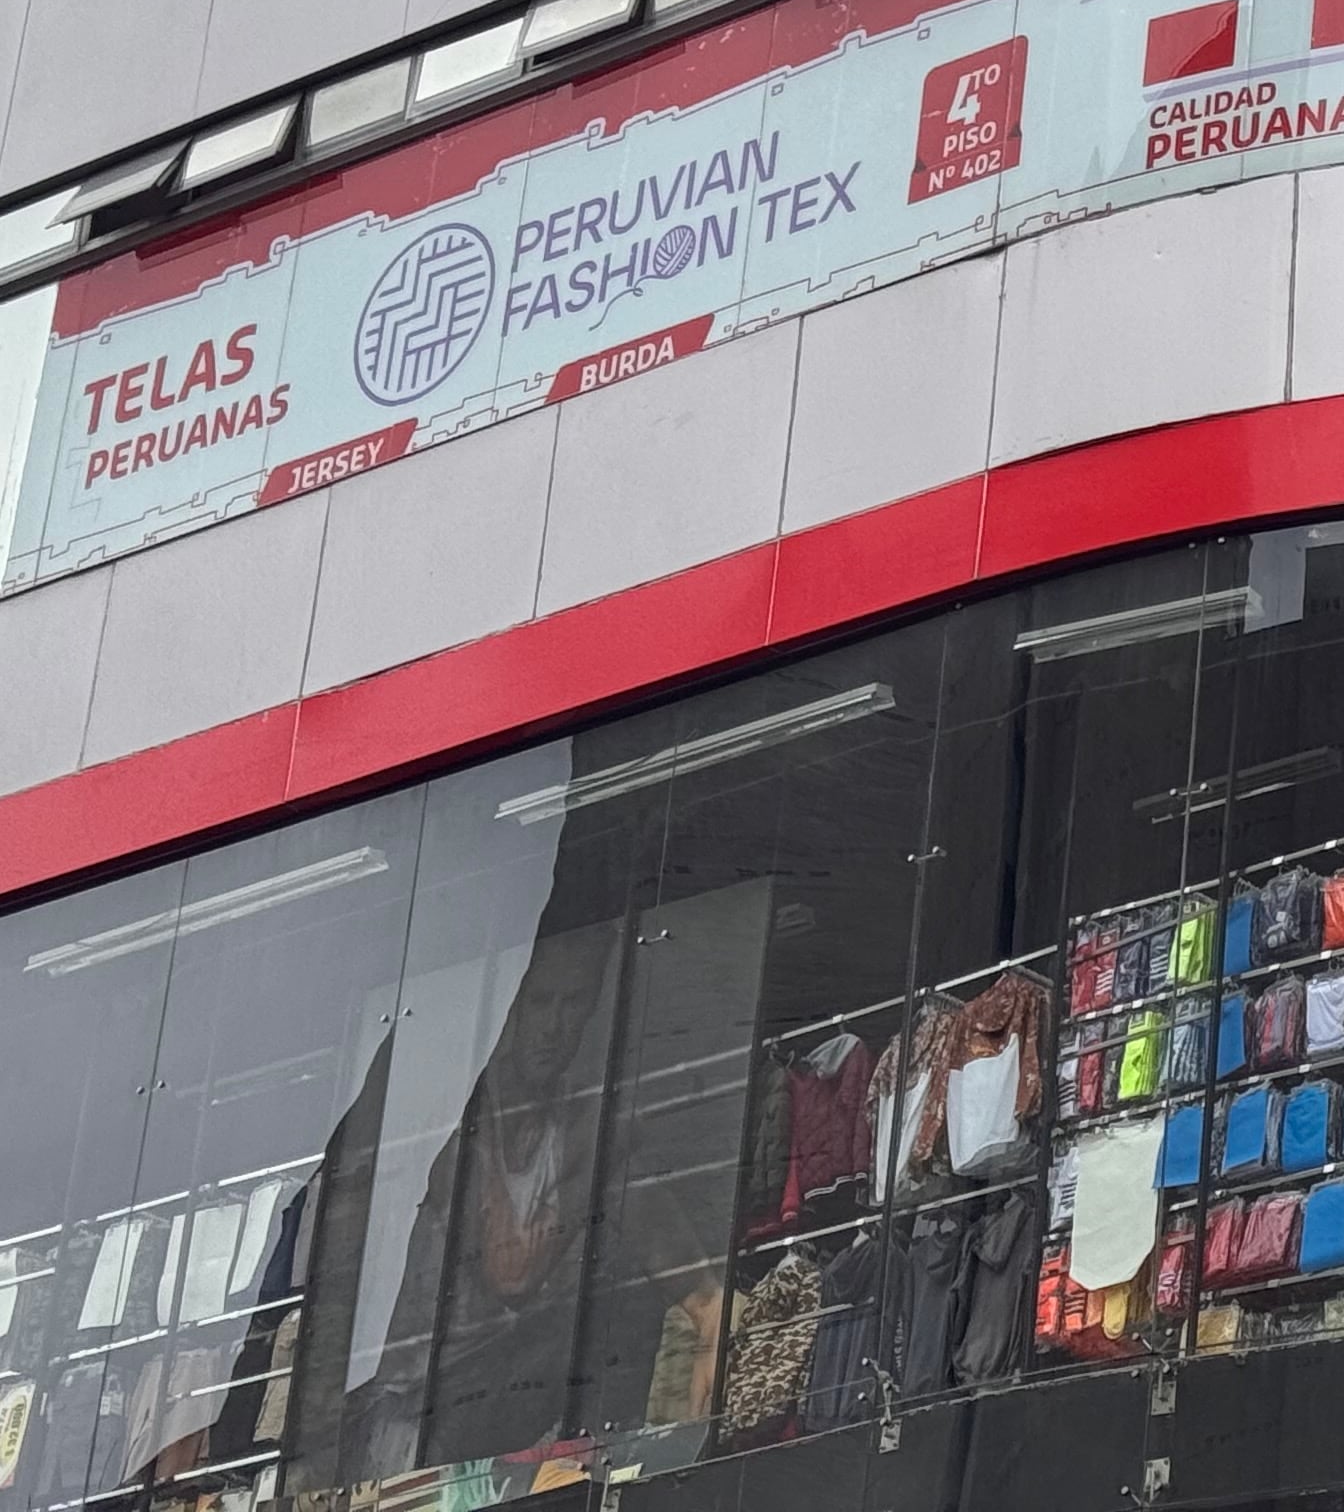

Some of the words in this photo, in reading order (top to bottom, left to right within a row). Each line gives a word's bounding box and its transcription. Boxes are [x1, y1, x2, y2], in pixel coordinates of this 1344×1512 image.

[1150, 81, 1278, 130] CALIDAD
[943, 121, 997, 158] PISO
[961, 149, 1002, 179] 402
[511, 130, 780, 275] PERUVIAN
[502, 205, 739, 338] FASHION
[757, 161, 863, 244] TEX
[84, 323, 258, 436] TELAS
[579, 336, 676, 394] BURDA
[84, 384, 291, 490] PERUANAS
[287, 437, 386, 495] JERSEY
